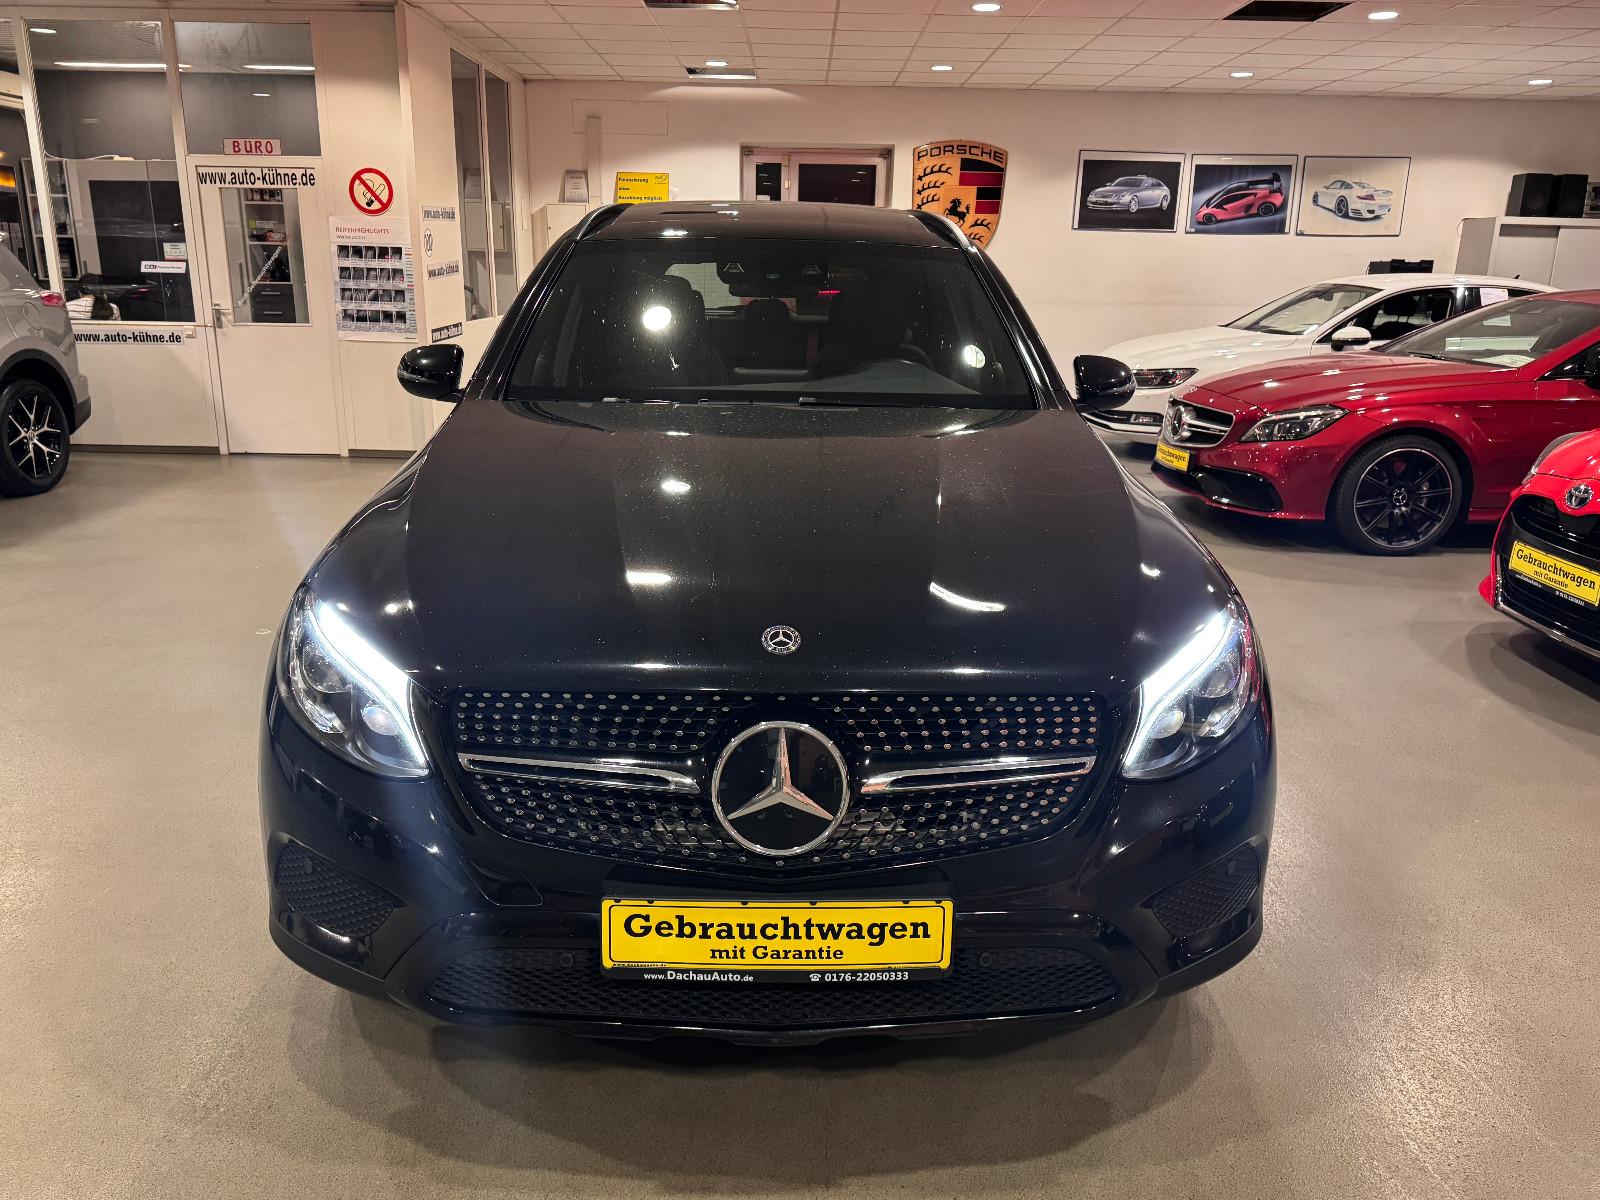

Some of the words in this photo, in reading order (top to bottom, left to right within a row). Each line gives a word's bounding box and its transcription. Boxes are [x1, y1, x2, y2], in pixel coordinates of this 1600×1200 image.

[232, 140, 274, 154] BÜRO
[917, 144, 1004, 164] PORSCHE
[197, 168, 316, 186] www.auto-kühne.de
[74, 331, 182, 343] www.auto-kühne.de
[1516, 548, 1596, 590] Gebrauchtwagen
[1543, 573, 1569, 589] Garantie
[623, 913, 931, 947] Gebrauchtwagen
[710, 945, 746, 960] mit
[752, 945, 844, 960] Garantie
[643, 970, 754, 982] www.DachauAuto.de
[824, 971, 909, 982] 0176-22050333
